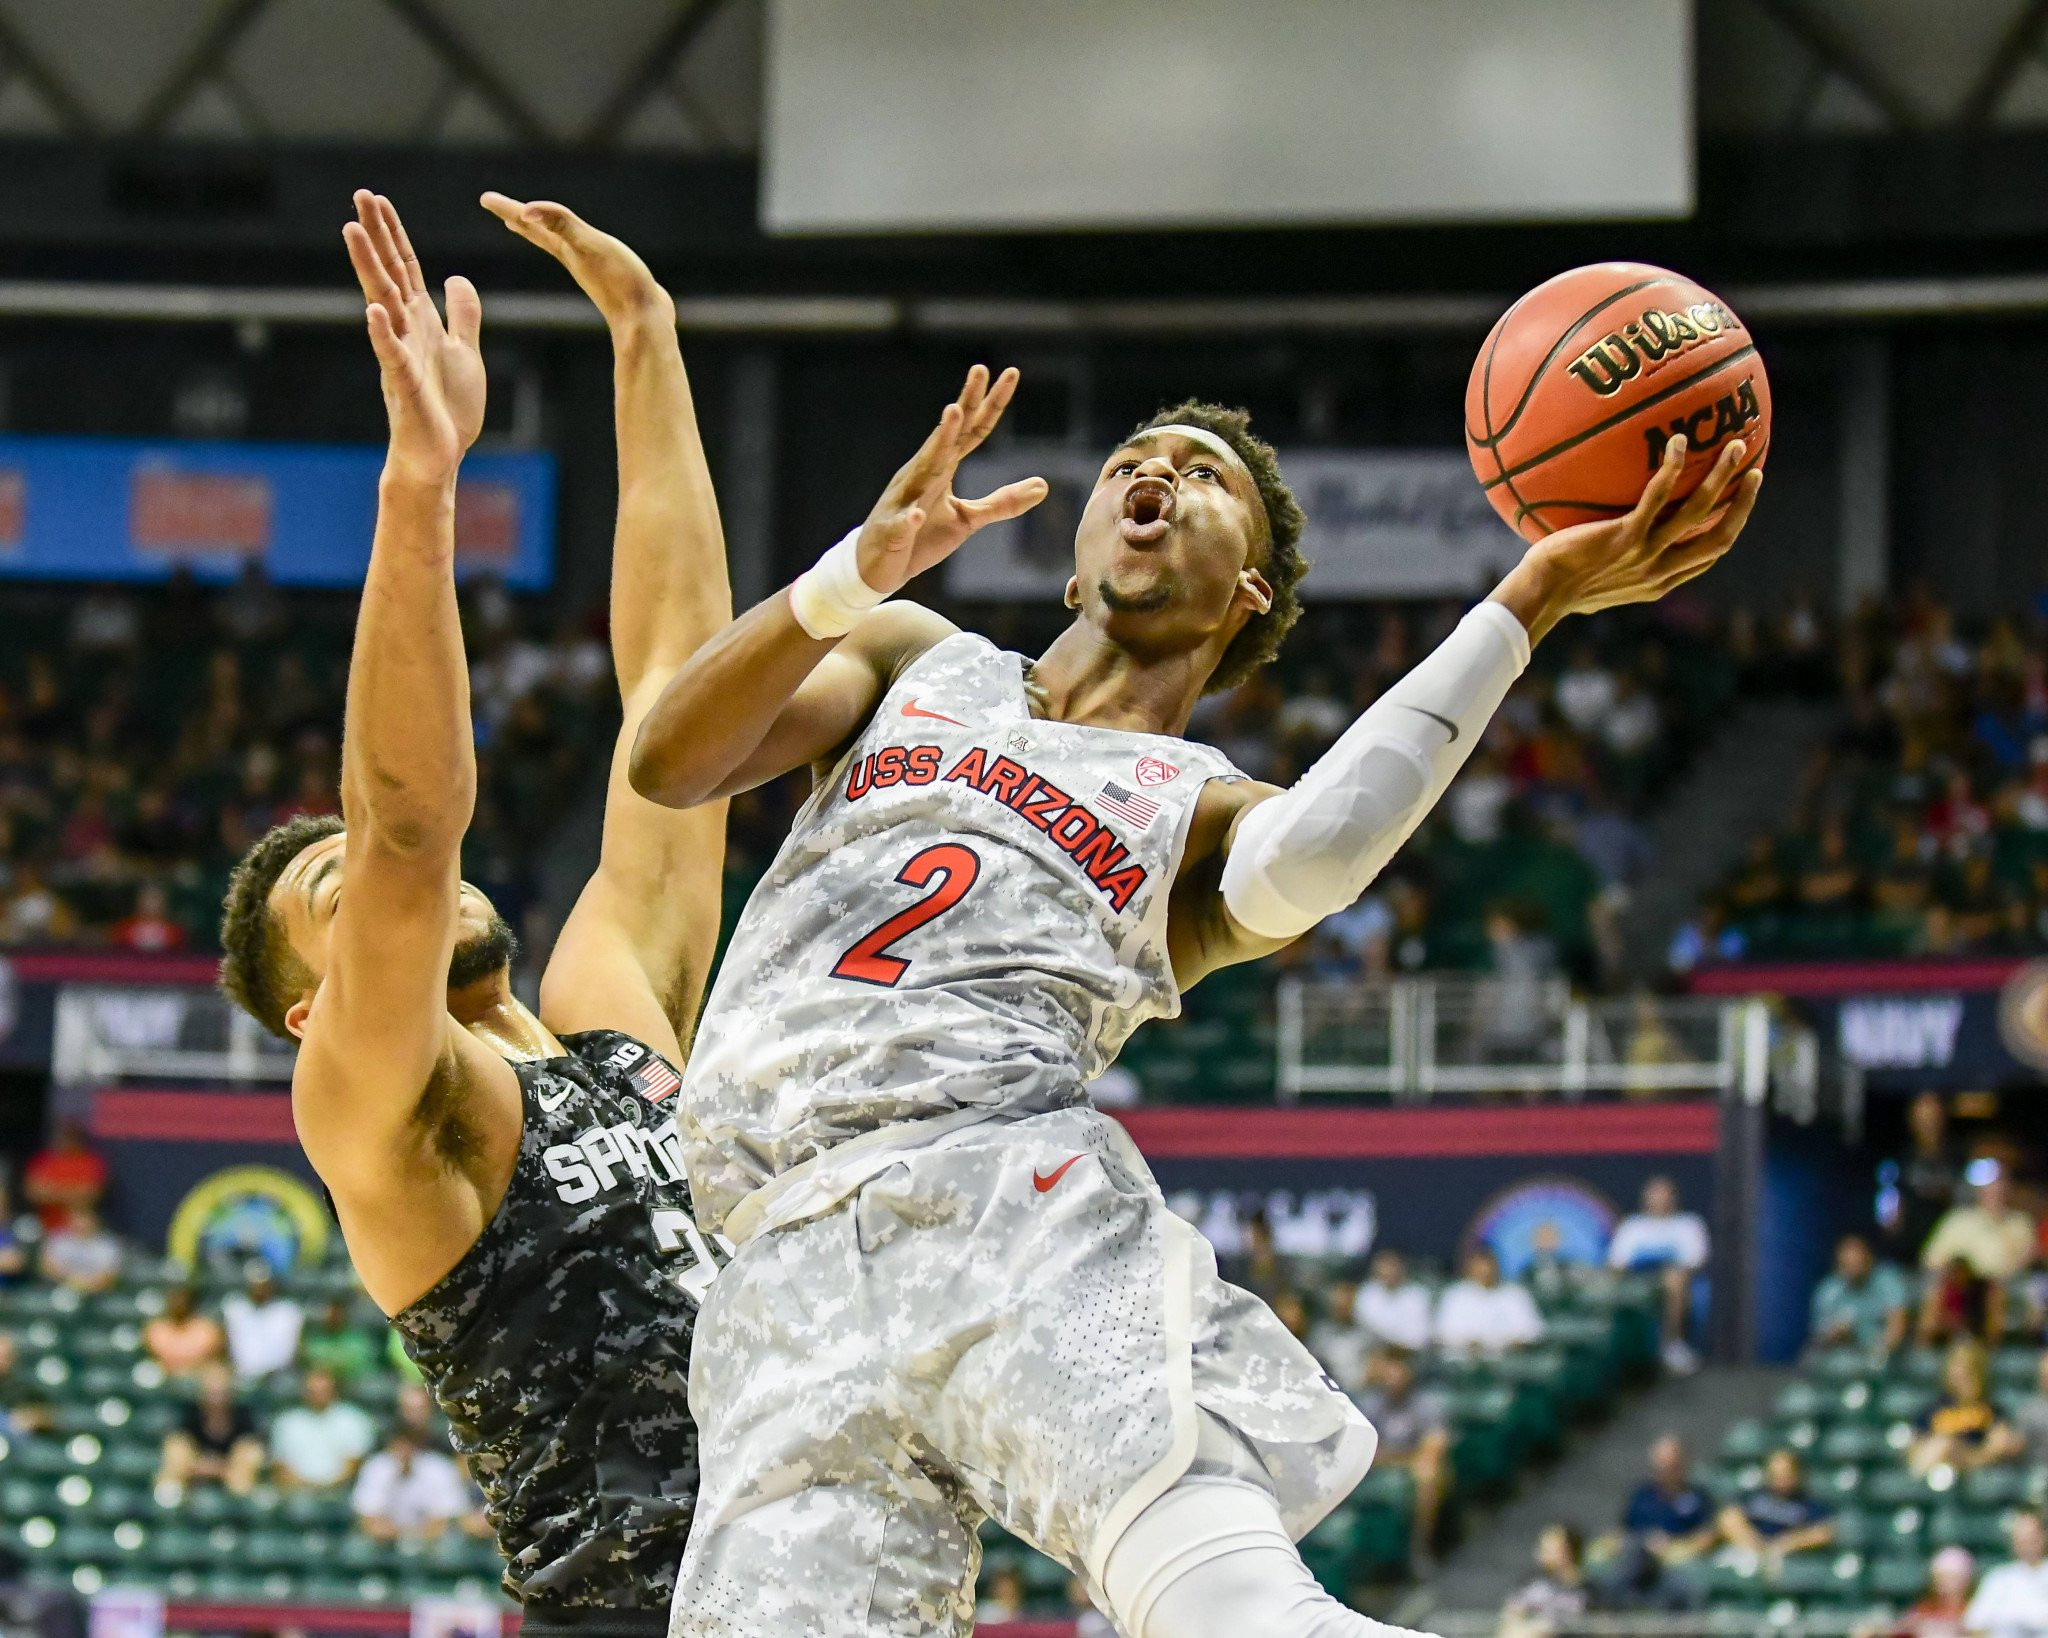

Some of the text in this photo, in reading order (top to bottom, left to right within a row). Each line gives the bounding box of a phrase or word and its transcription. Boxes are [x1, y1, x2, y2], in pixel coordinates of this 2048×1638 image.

[1644, 377, 1761, 471] NCAA
[846, 745, 1148, 915] USS ARIZONA
[829, 843, 981, 988] 2
